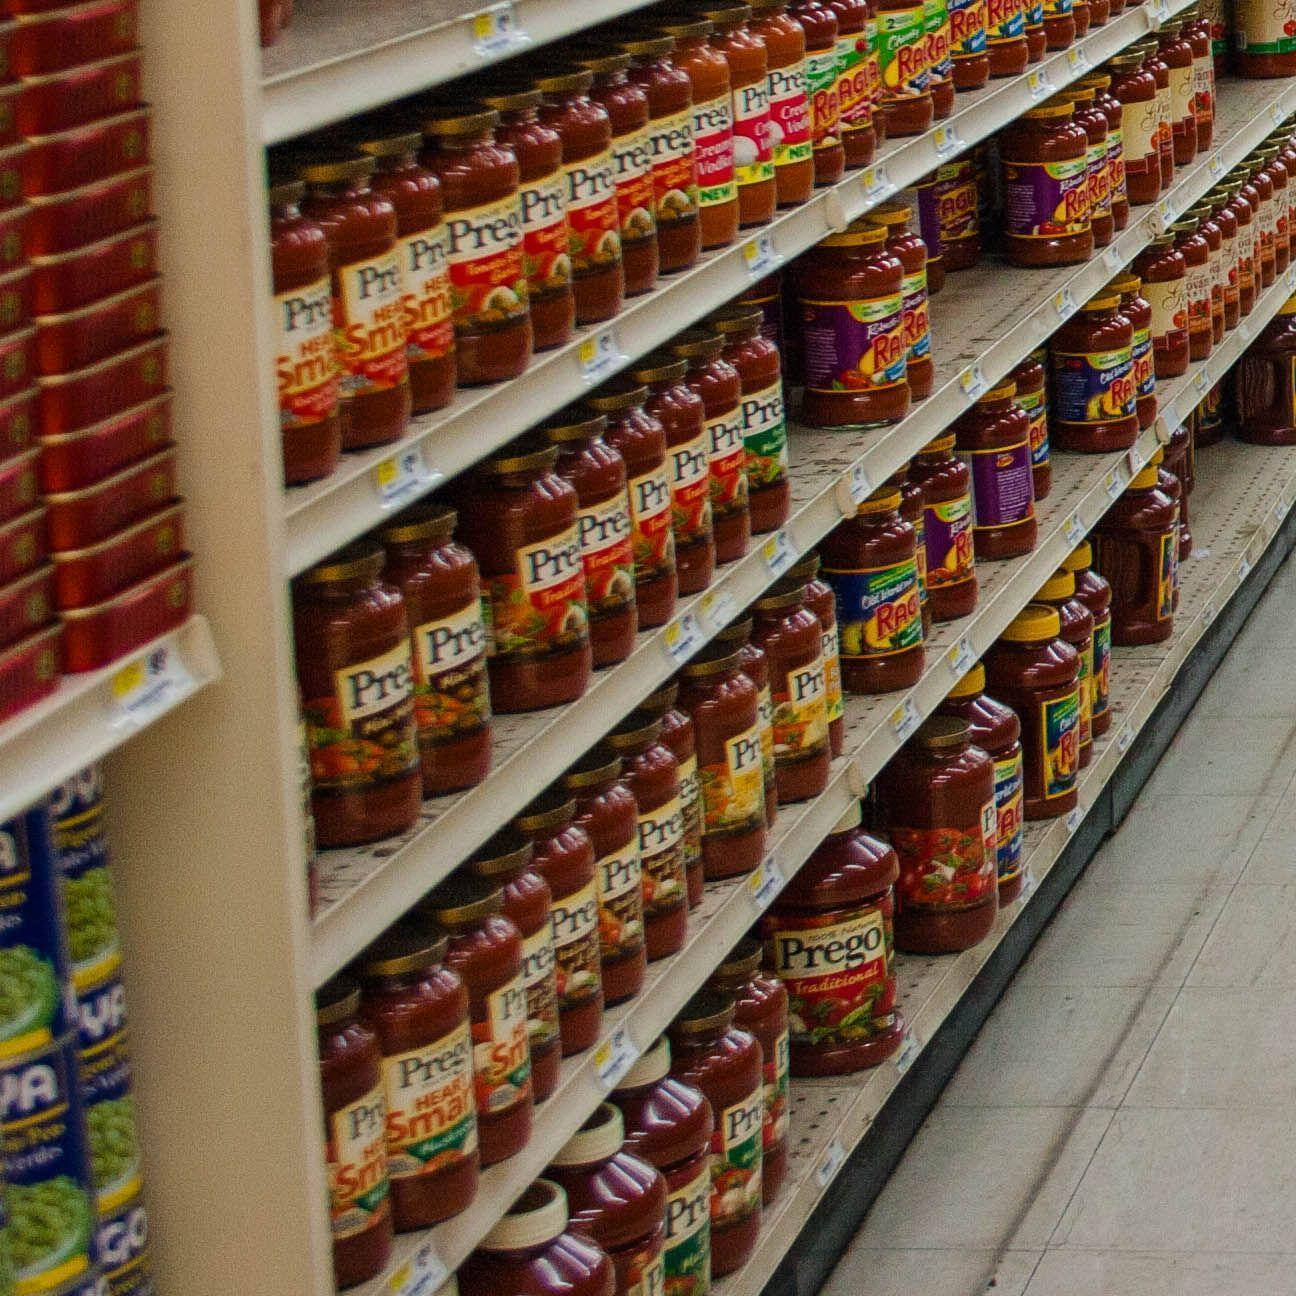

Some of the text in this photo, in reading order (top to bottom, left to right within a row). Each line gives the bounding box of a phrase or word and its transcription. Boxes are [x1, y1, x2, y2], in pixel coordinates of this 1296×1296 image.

[567, 167, 614, 202] Pre
[700, 188, 731, 202] NEW
[521, 187, 564, 224] Pre
[447, 212, 518, 254] Preg
[742, 398, 781, 430] Pre
[577, 510, 630, 548] Pre
[528, 541, 578, 584] Pre
[875, 595, 917, 638] RAG
[428, 623, 484, 665] Pre
[349, 660, 411, 709] Pre
[552, 899, 597, 939] Pre
[780, 927, 881, 971] Prego
[795, 961, 879, 995] Traditional
